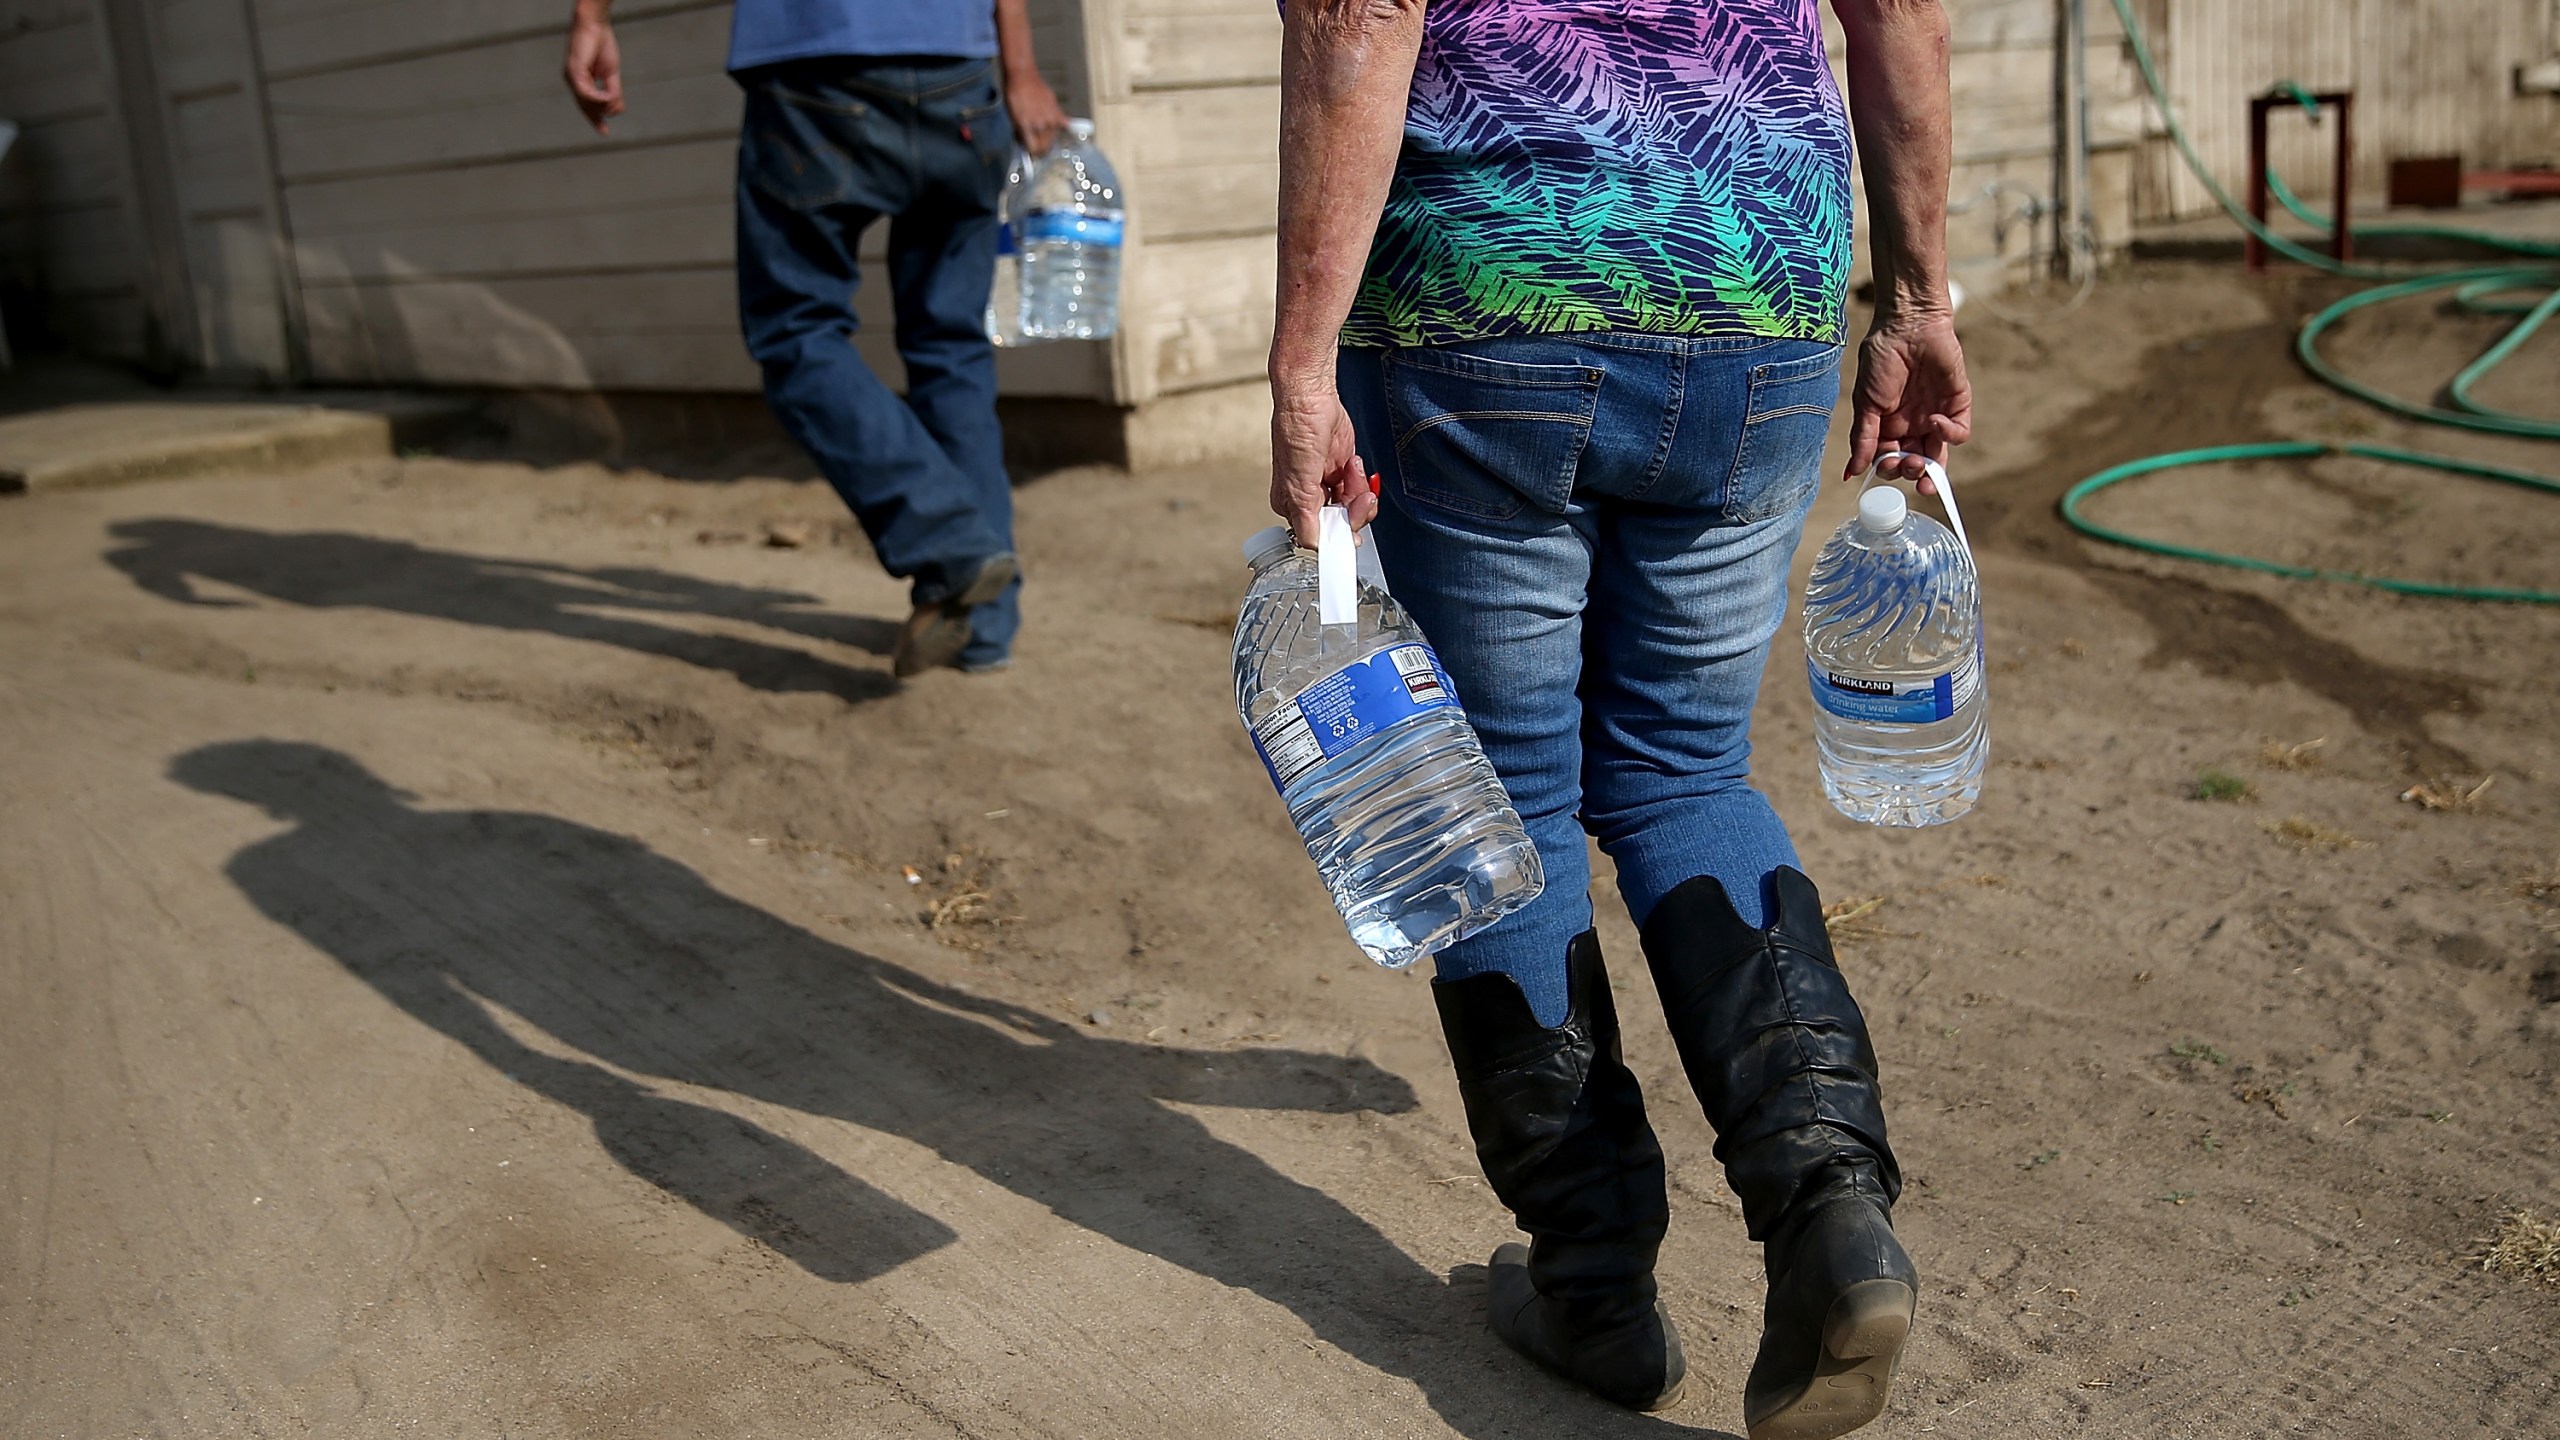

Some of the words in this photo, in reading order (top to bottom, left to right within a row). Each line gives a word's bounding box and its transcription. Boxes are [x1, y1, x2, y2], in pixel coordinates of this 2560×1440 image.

[1831, 674, 1891, 691] KIRKLAND
[1278, 701, 1297, 715] Facts
[1827, 695, 1866, 712] drinking
[1868, 703, 1898, 713] water
